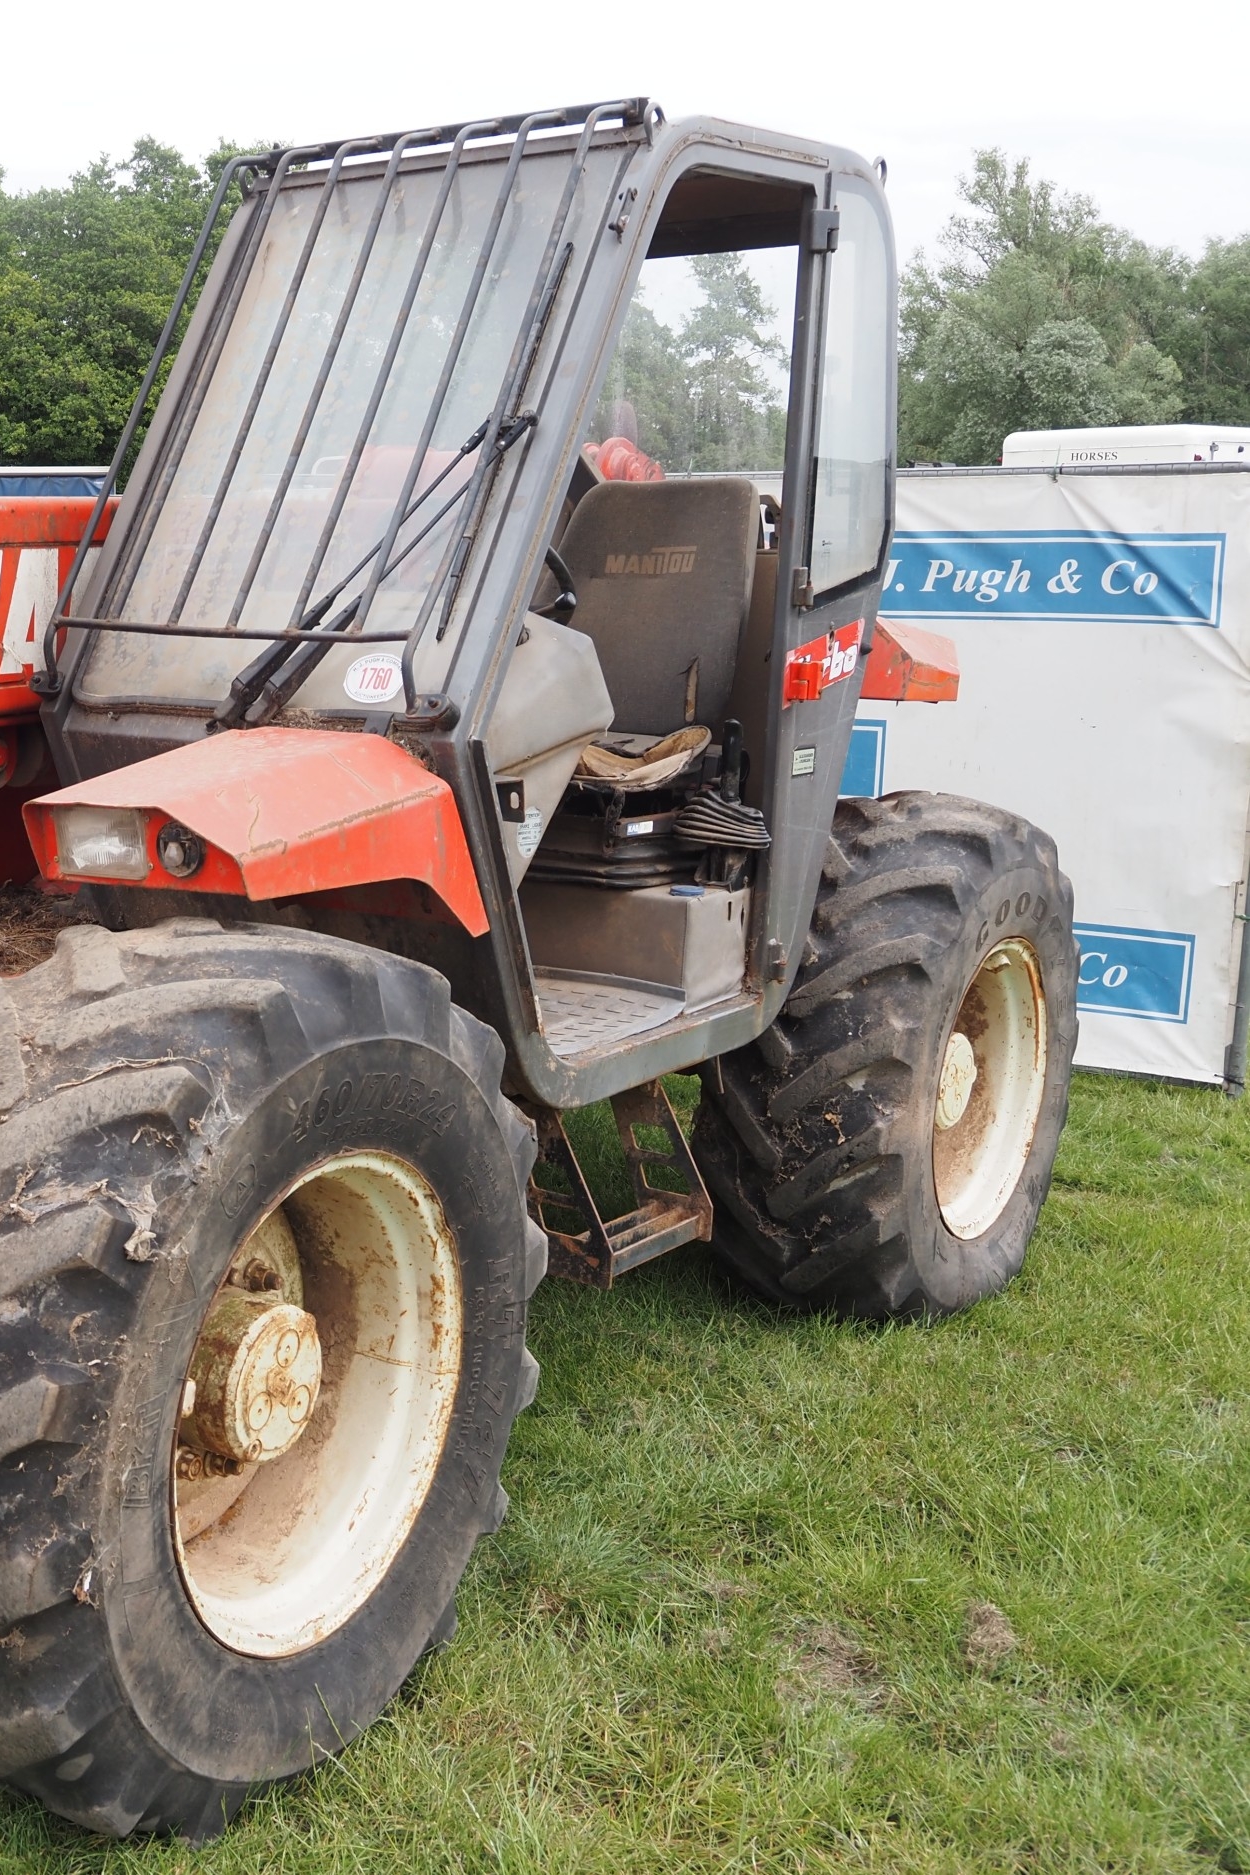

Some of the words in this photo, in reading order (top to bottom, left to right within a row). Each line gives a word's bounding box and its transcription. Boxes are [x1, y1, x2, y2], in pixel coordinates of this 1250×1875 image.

[1070, 451, 1118, 462] HORSES
[604, 545, 698, 575] MANITOU
[919, 558, 1031, 603] Pugh
[1046, 558, 1083, 595] &
[1101, 559, 1159, 596] Co
[358, 666, 393, 690] 1760
[1077, 951, 1128, 988] Co
[454, 1343, 483, 1459] INDUSTRIAL
